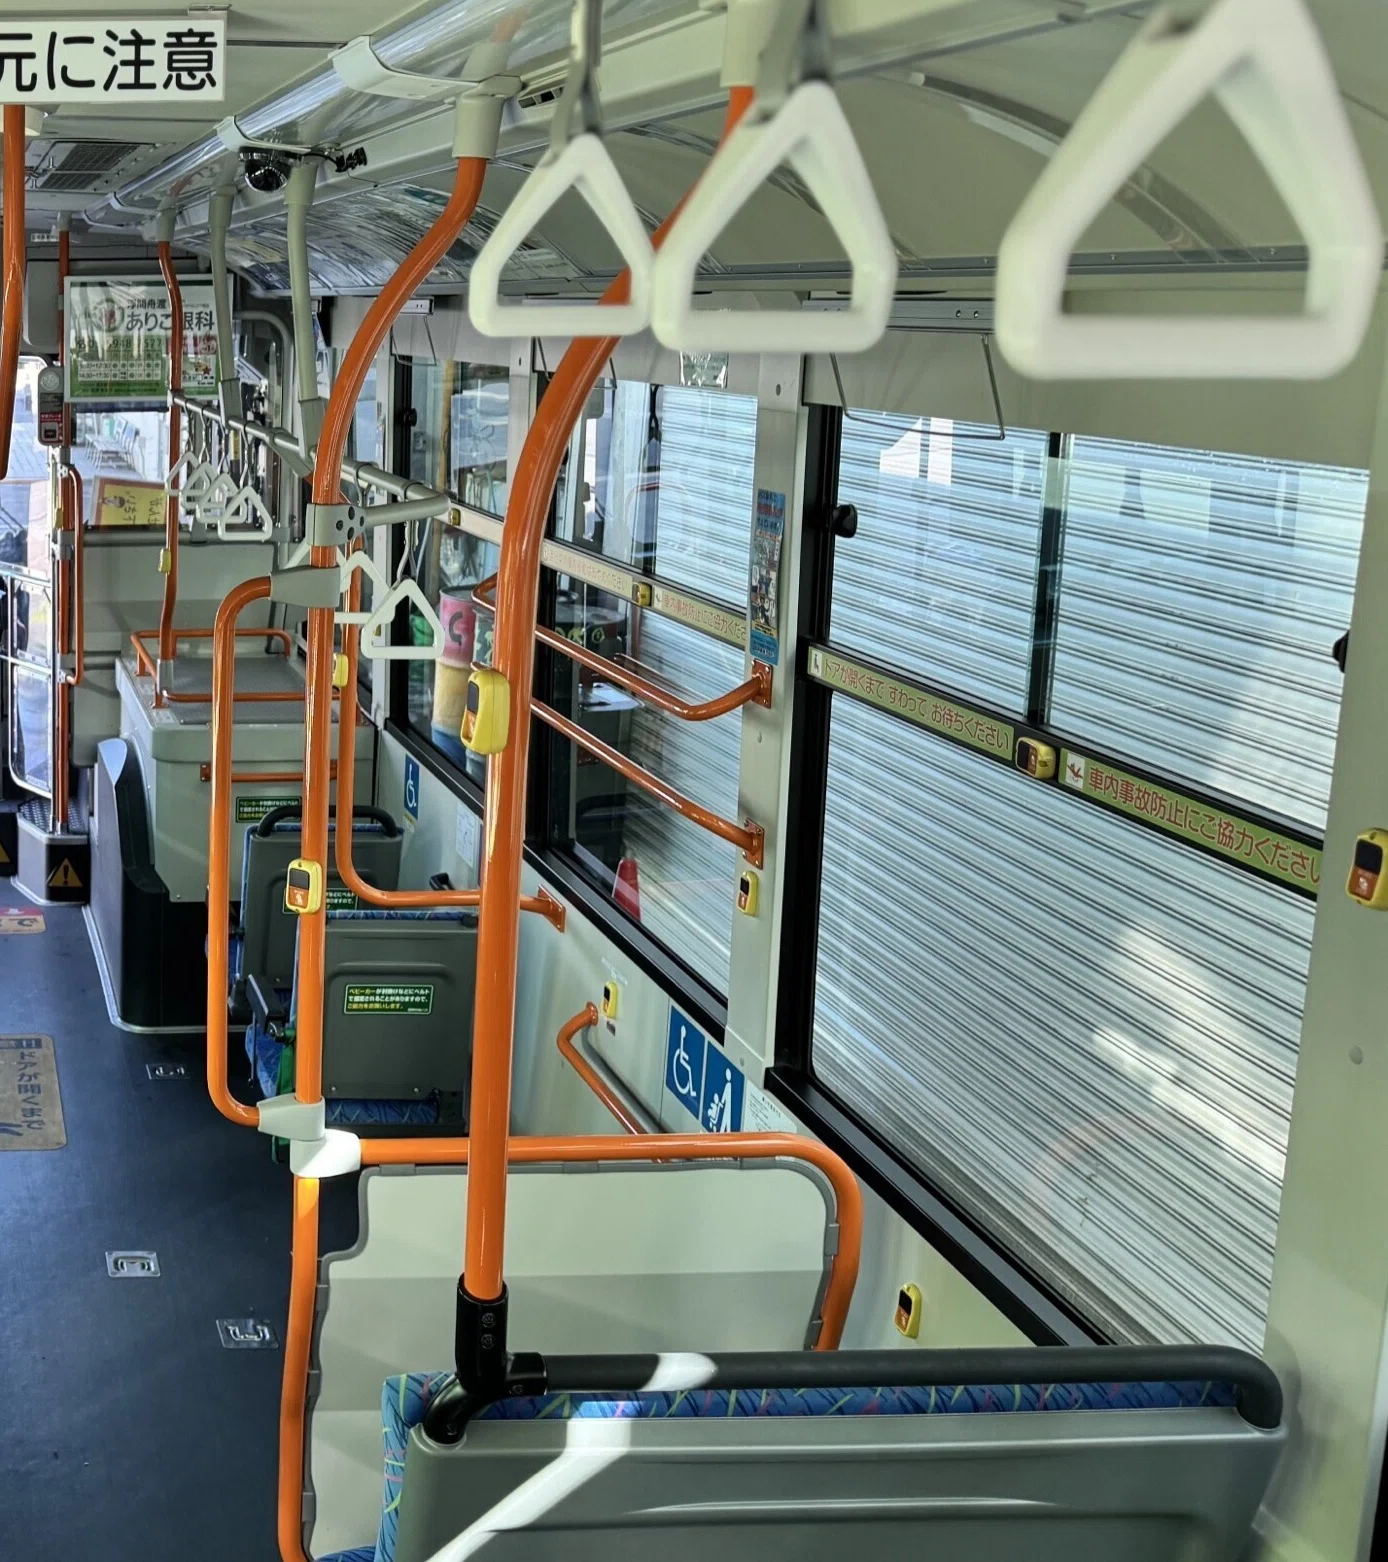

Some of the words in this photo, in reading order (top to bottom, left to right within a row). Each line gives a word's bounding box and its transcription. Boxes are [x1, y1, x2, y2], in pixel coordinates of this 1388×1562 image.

[823, 657, 884, 699] ドアが開くまで
[889, 685, 926, 717] すわって
[931, 702, 1010, 750] お待ちください
[16, 1051, 45, 1131] ドアが開くまで
